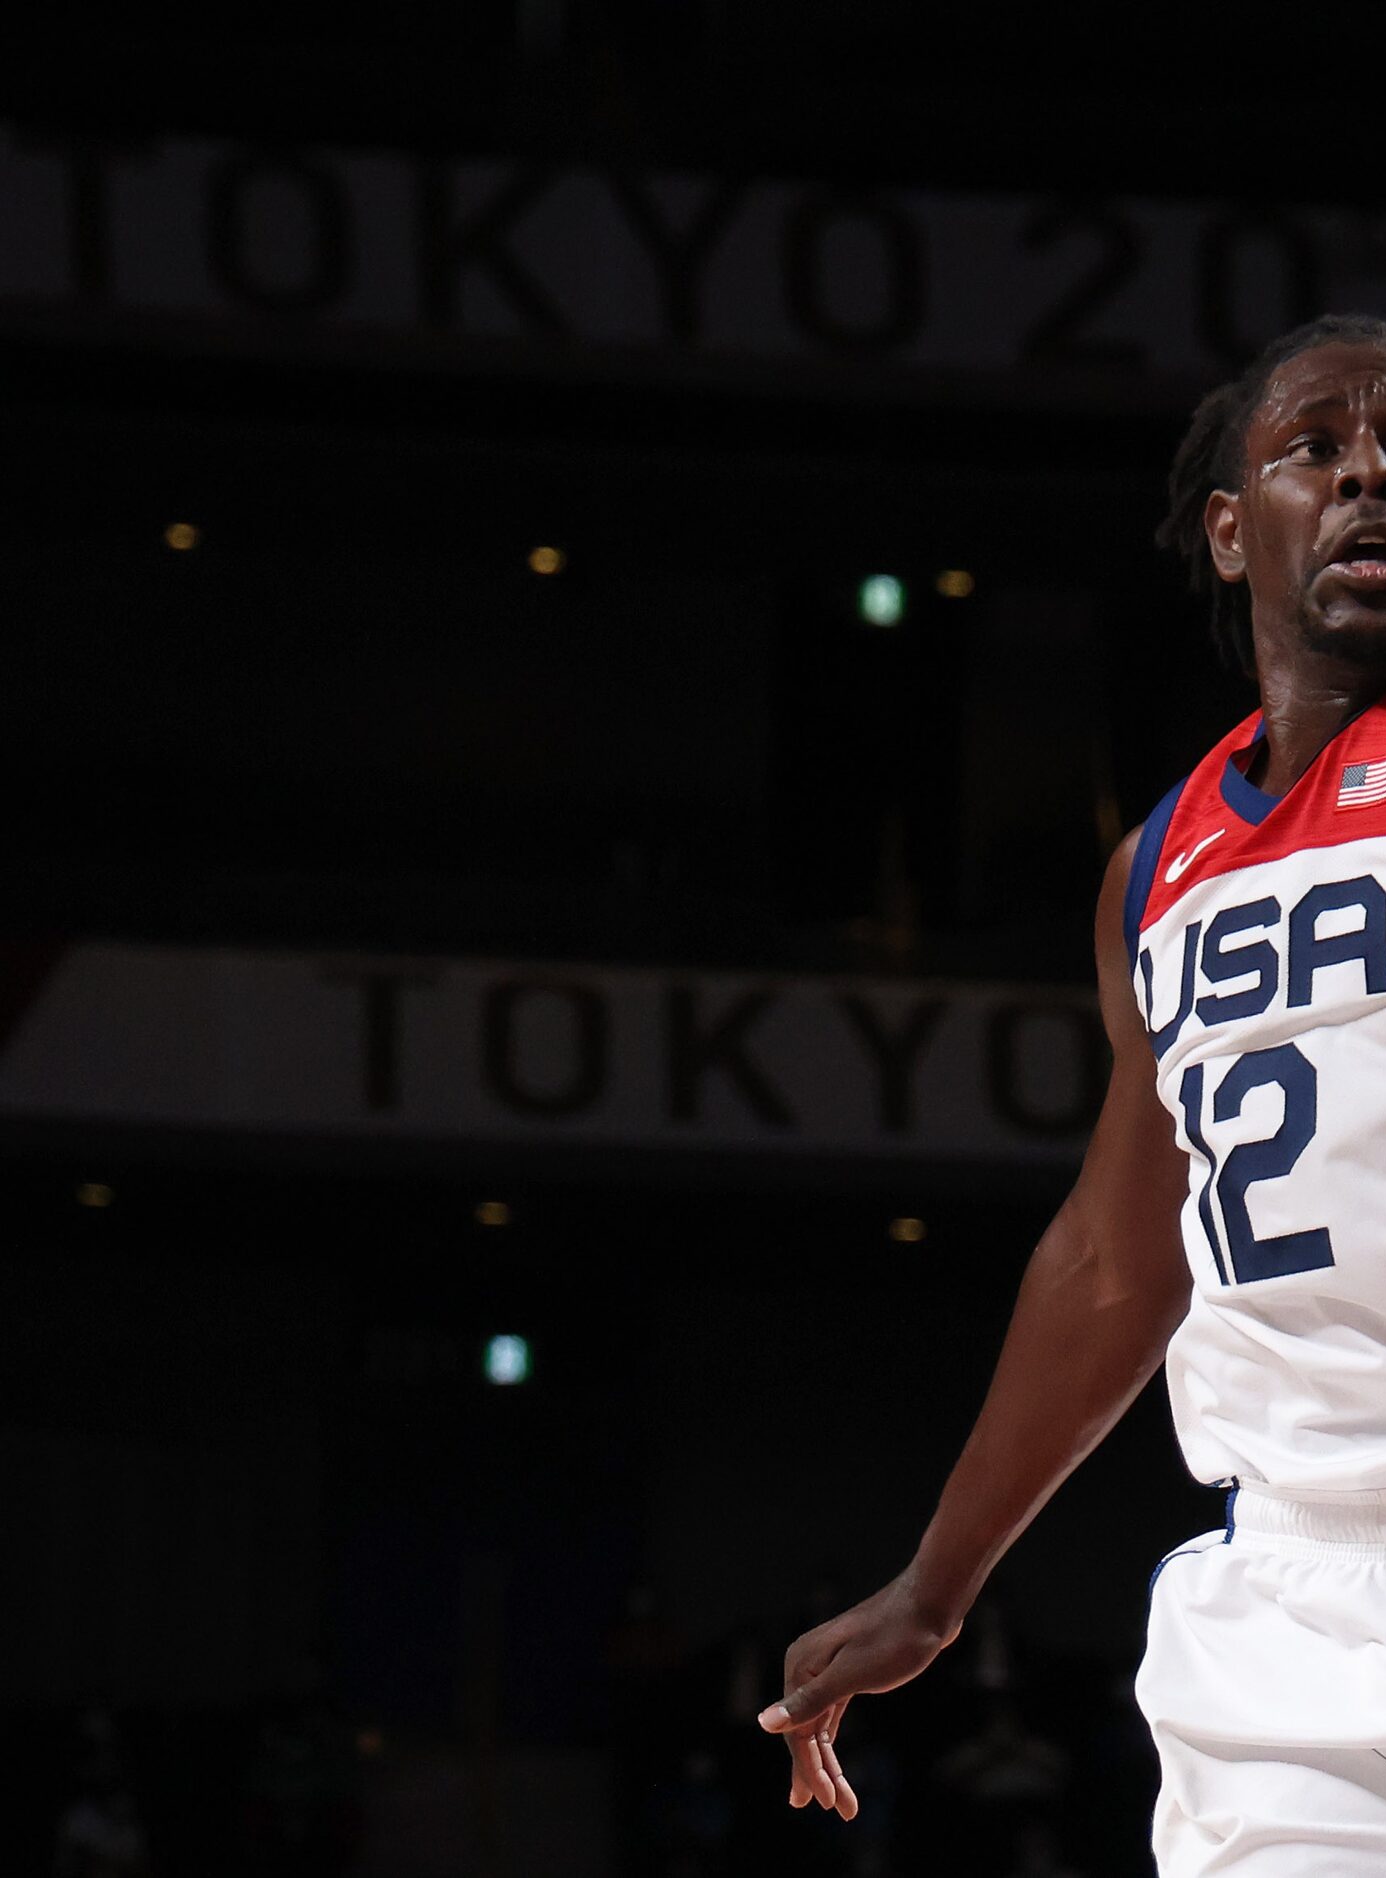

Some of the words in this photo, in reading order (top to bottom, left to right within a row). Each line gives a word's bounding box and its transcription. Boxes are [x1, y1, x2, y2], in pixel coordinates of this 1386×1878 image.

[25, 128, 933, 357] TOKYO
[317, 956, 1114, 1136] TOKYO
[1179, 1042, 1335, 1287] 12
